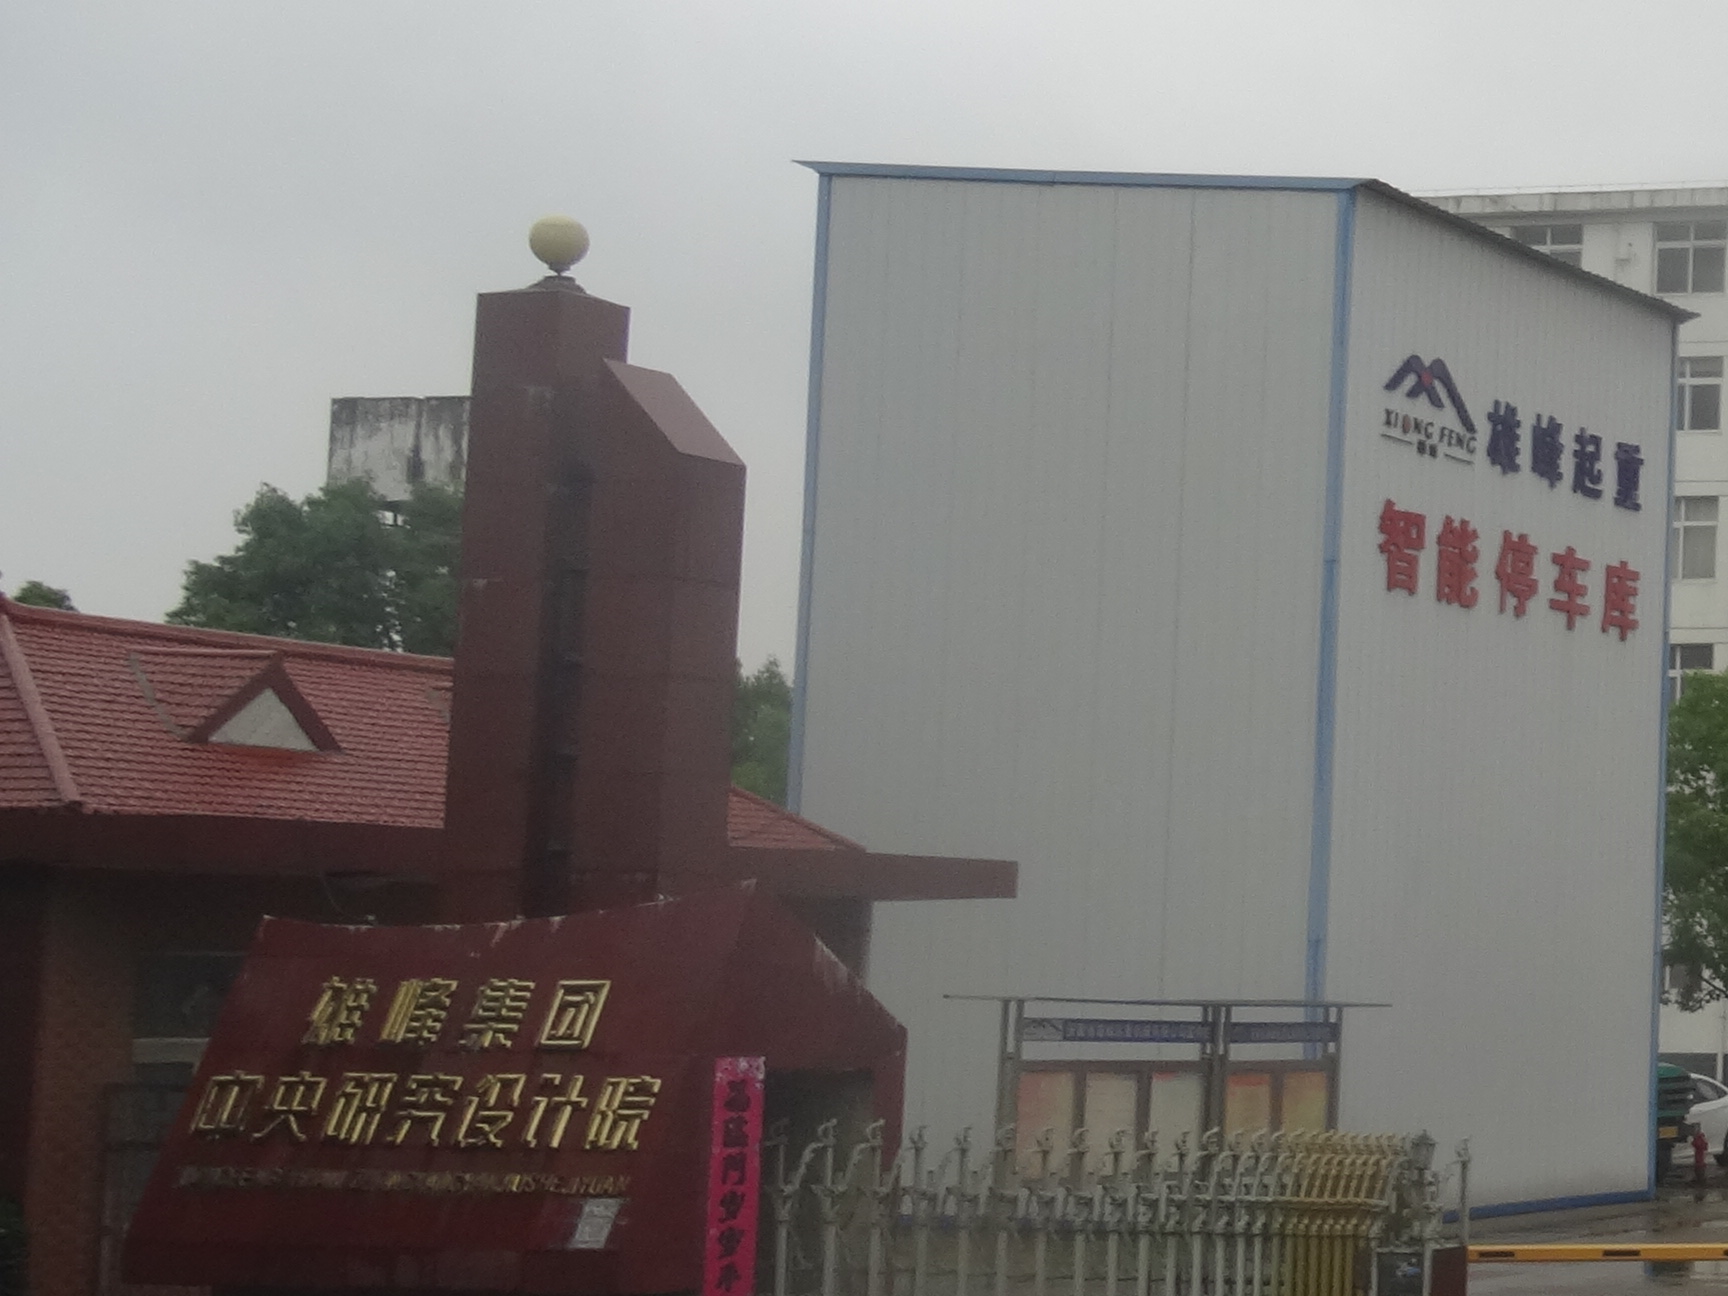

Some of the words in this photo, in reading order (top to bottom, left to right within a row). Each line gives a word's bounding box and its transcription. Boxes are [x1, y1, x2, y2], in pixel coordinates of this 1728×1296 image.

[1486, 400, 1644, 511] 雄峰起重
[1378, 498, 1640, 641] 智能停车库
[302, 975, 612, 1049] 雄峰集团
[189, 1069, 661, 1151] 中央研究设计院
